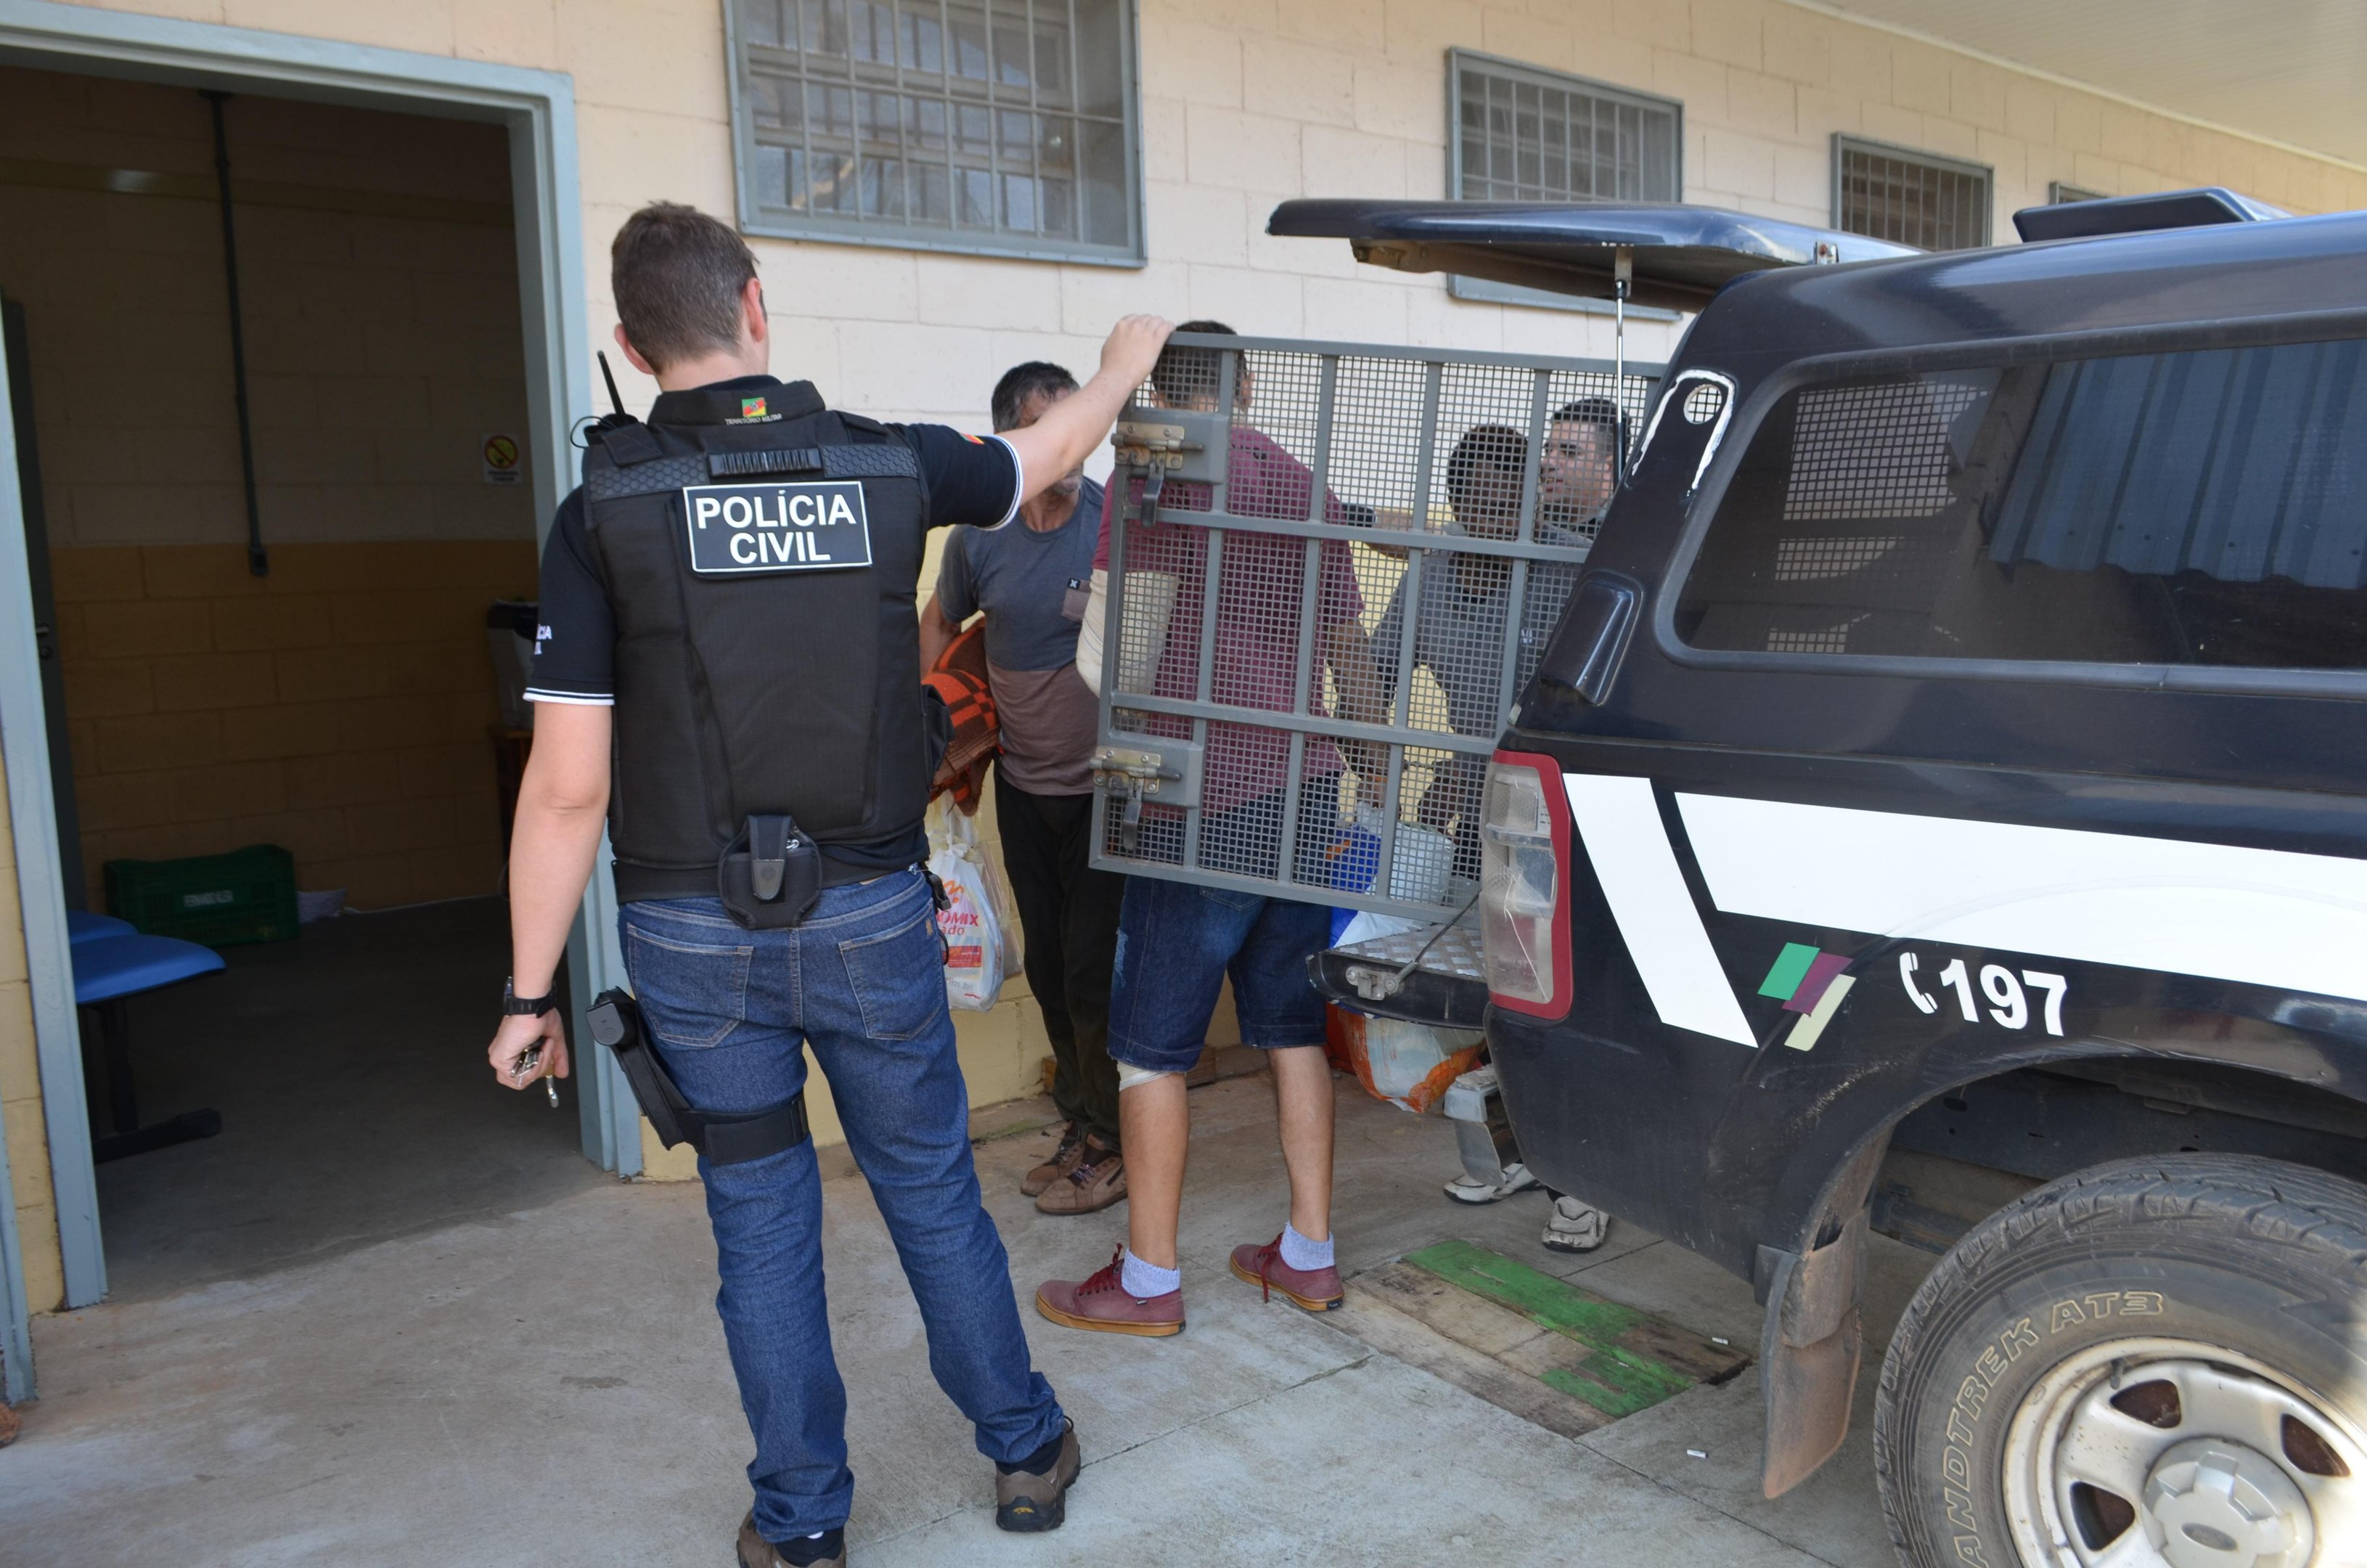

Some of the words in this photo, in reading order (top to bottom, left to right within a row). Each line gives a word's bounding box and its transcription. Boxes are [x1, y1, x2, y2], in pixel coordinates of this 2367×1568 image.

[695, 490, 857, 528] POLÍCIA
[729, 531, 831, 564] CIVIL
[1939, 958, 2067, 1037] 197
[2051, 1291, 2163, 1334] AT3
